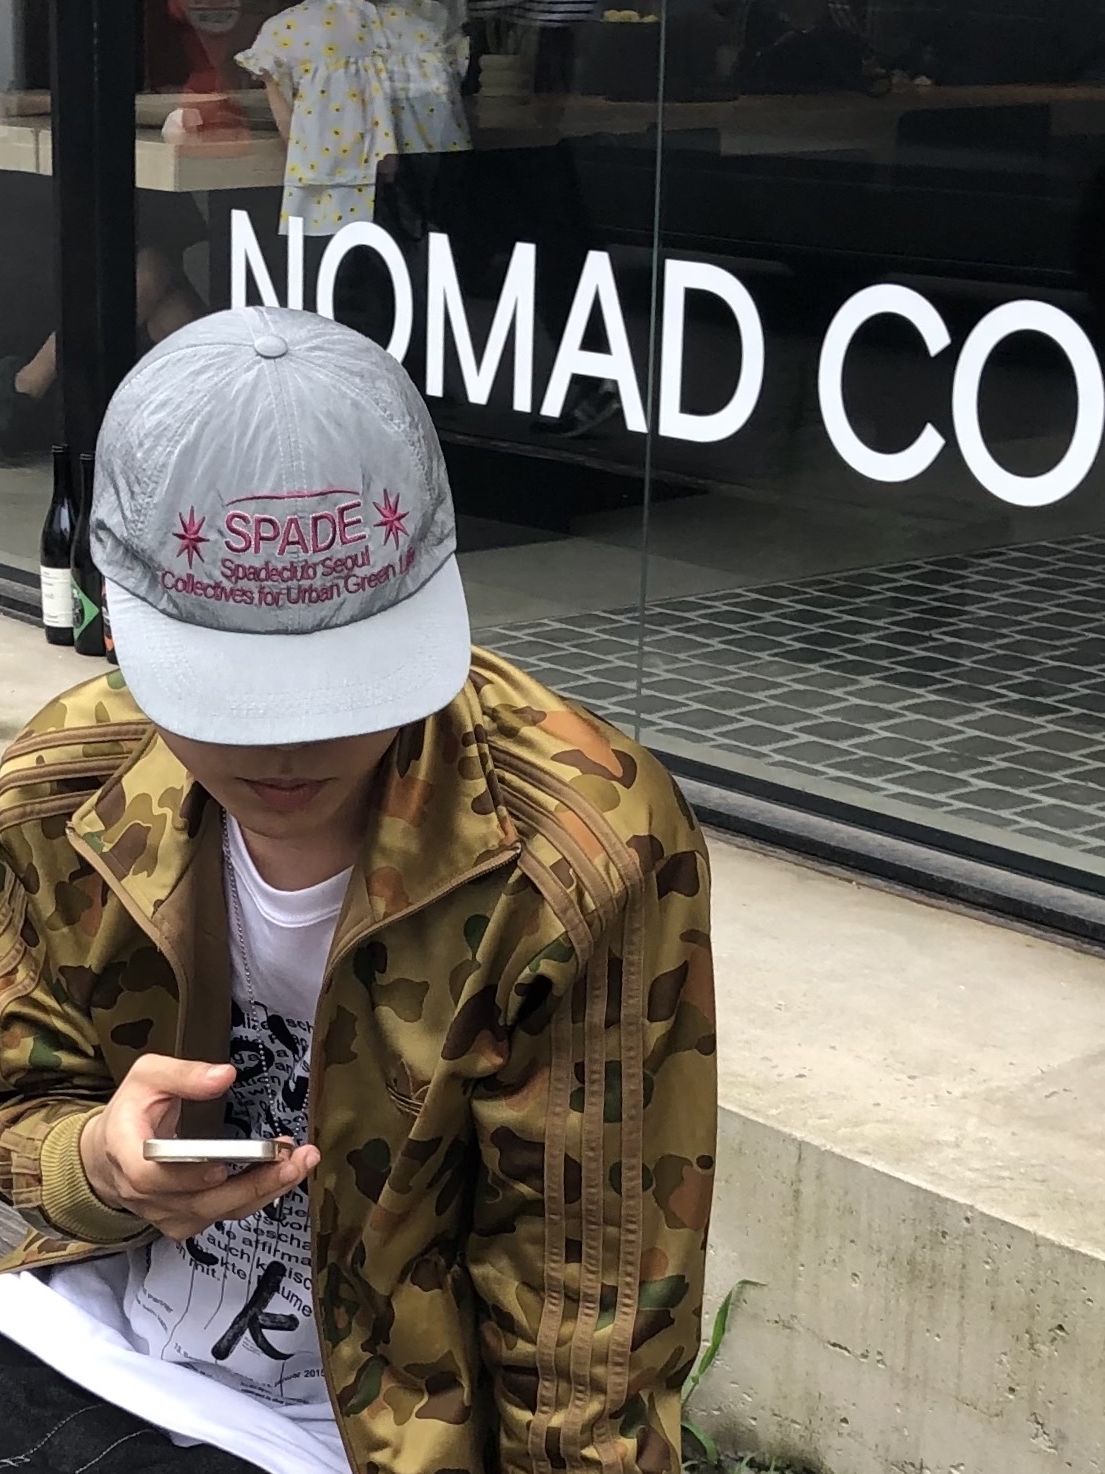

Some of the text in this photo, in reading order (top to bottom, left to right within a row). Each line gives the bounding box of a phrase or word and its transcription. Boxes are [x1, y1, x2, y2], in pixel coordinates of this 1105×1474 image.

[231, 209, 764, 443] NOMAD
[225, 501, 366, 556] SPADE
[160, 570, 255, 606] Collectives
[258, 586, 281, 608] for
[286, 582, 341, 605] Urban
[345, 563, 397, 594] Green
[321, 545, 372, 577] Seoul
